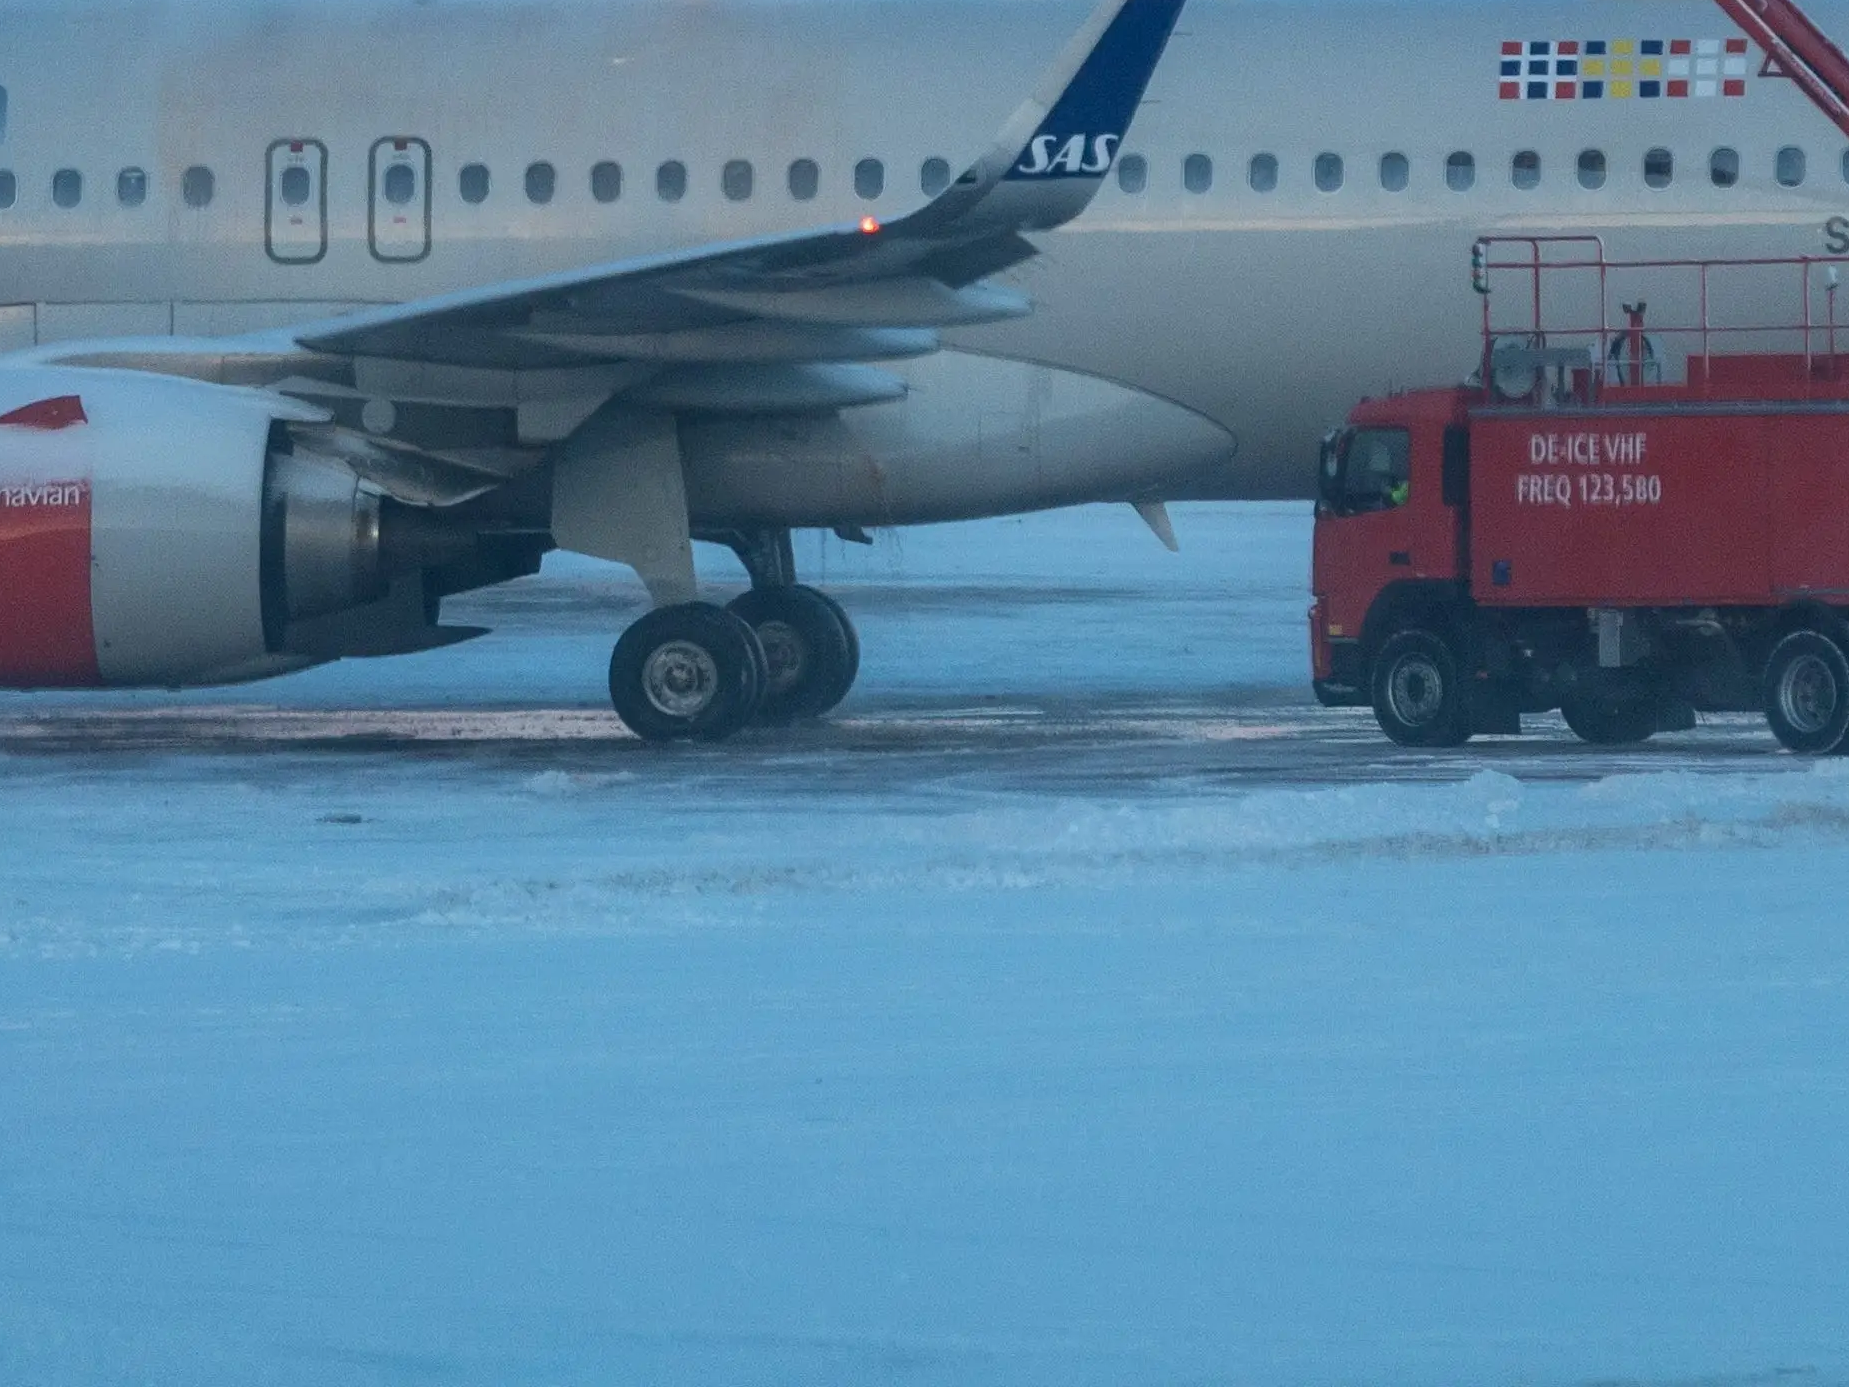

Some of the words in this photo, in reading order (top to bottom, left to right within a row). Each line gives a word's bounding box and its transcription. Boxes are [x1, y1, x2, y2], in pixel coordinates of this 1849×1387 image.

[1018, 133, 1119, 174] SAS
[1530, 432, 1600, 465] DE-ICE
[1604, 432, 1647, 465] VHF
[1517, 473, 1571, 508] FREQ
